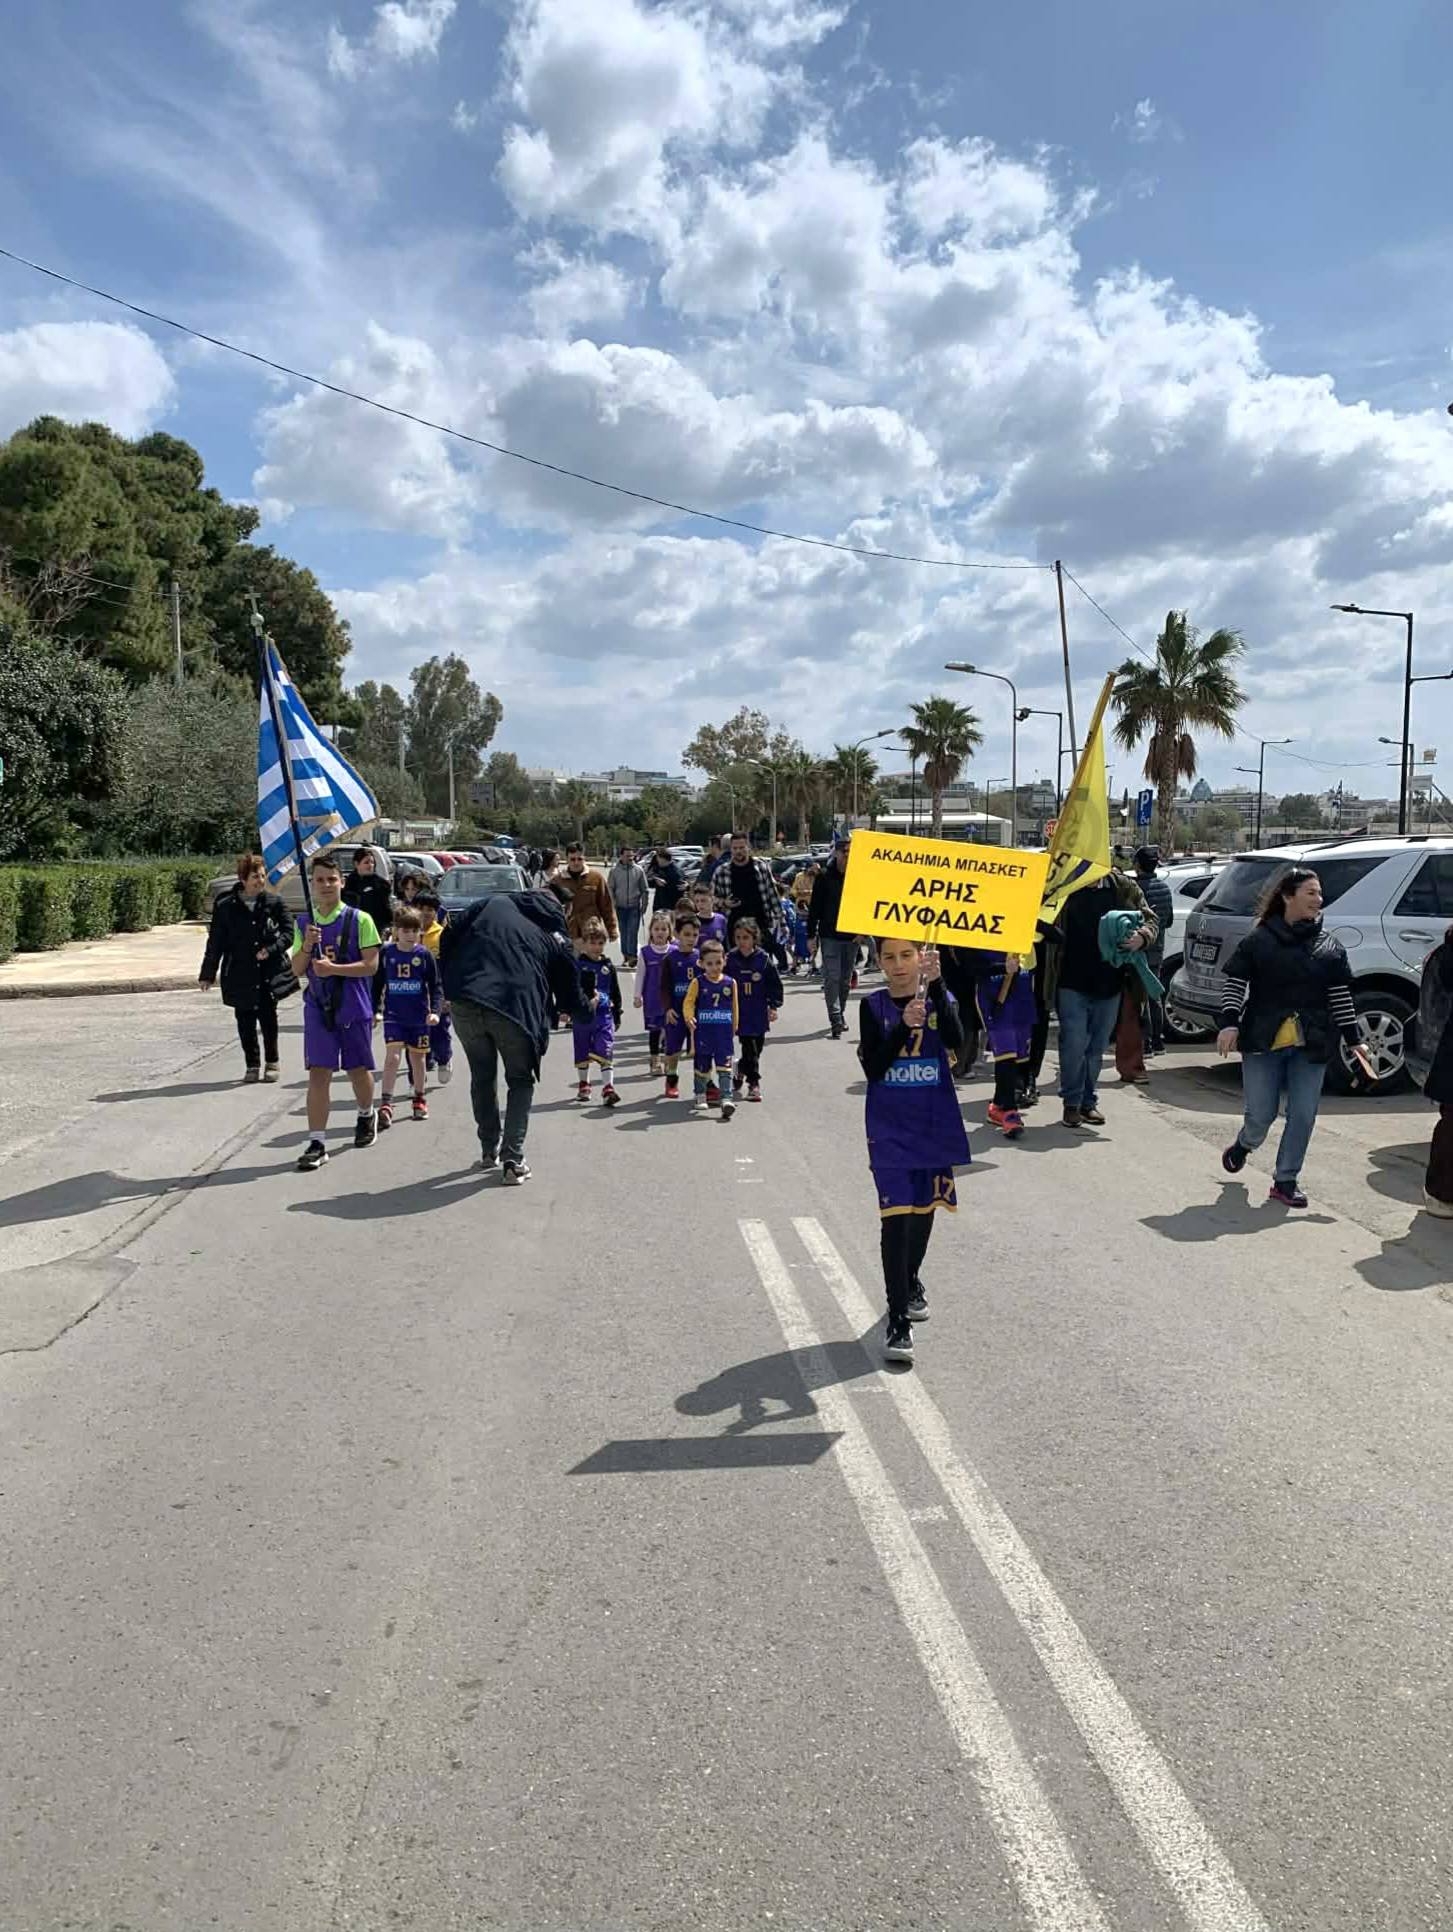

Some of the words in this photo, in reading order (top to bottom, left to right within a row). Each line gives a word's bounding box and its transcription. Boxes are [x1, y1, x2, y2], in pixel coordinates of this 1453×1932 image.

[1140, 791, 1150, 811] P
[871, 848, 951, 869] ΑΚΑΔΗΜΙΑ
[955, 858, 1028, 879] ΜΠΑΣΚΕΤ
[909, 877, 980, 904] ΑΡΗΣ
[872, 900, 1006, 935] ΓΛΥΦΑΔΑΣ
[396, 963, 411, 978] 13
[388, 981, 421, 992] molten
[712, 993, 721, 1007] 7
